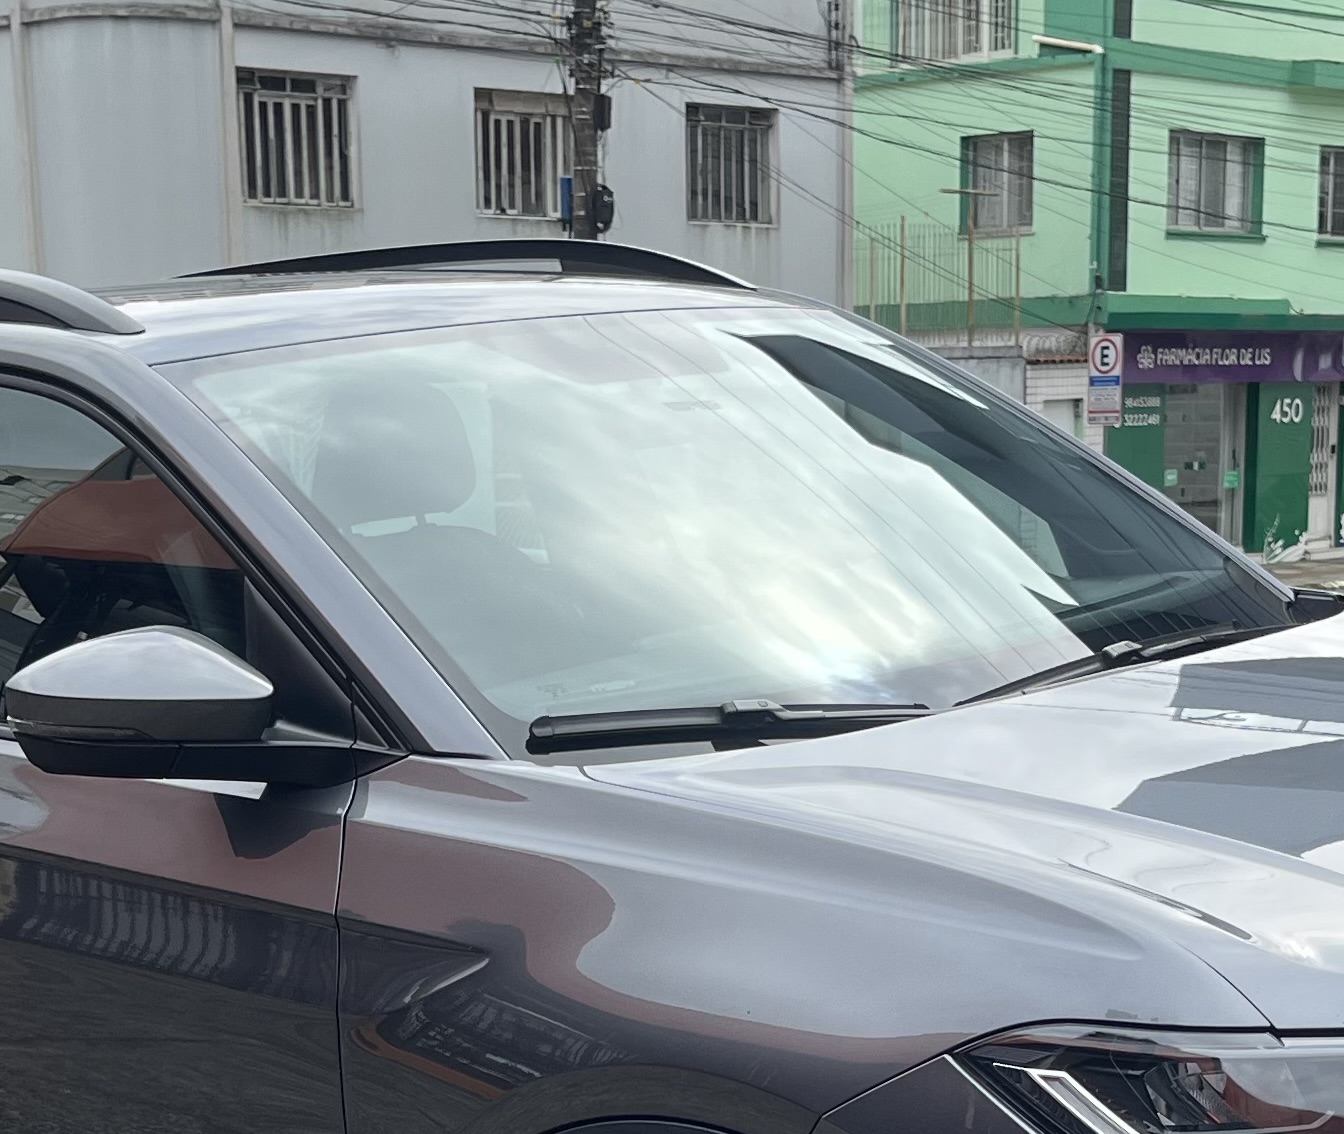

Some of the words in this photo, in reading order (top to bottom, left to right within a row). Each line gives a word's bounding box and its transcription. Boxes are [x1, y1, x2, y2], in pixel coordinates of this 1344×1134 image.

[1100, 346, 1110, 367] E
[1156, 343, 1211, 366] FARMÁCIA
[1212, 348, 1238, 366] FLOR
[1239, 348, 1254, 366] DE
[1255, 348, 1272, 366] LIS
[1270, 398, 1304, 424] 450
